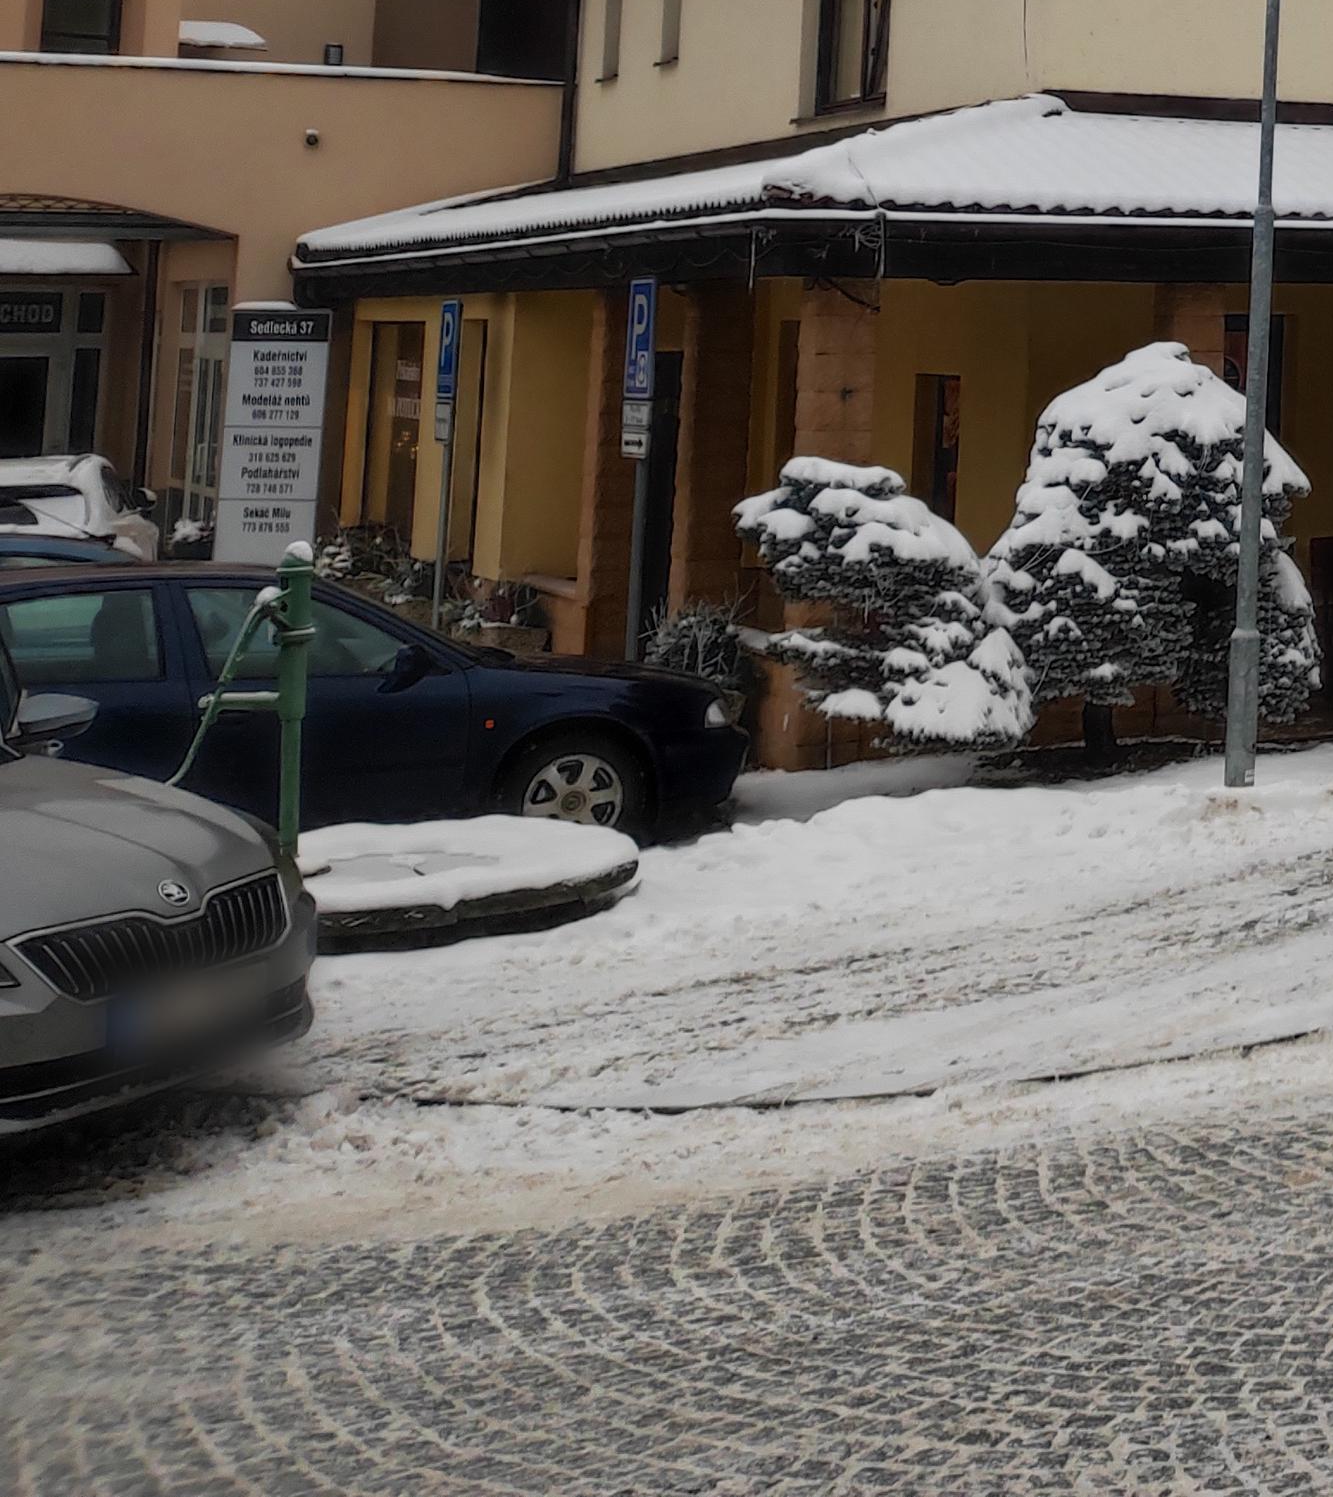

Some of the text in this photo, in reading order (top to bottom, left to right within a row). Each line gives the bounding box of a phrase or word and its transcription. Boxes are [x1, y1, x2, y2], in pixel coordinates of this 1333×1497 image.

[250, 319, 314, 335] Sedlecká 37
[242, 392, 282, 406] Modeláž
[232, 434, 312, 449] Klinická logopedie
